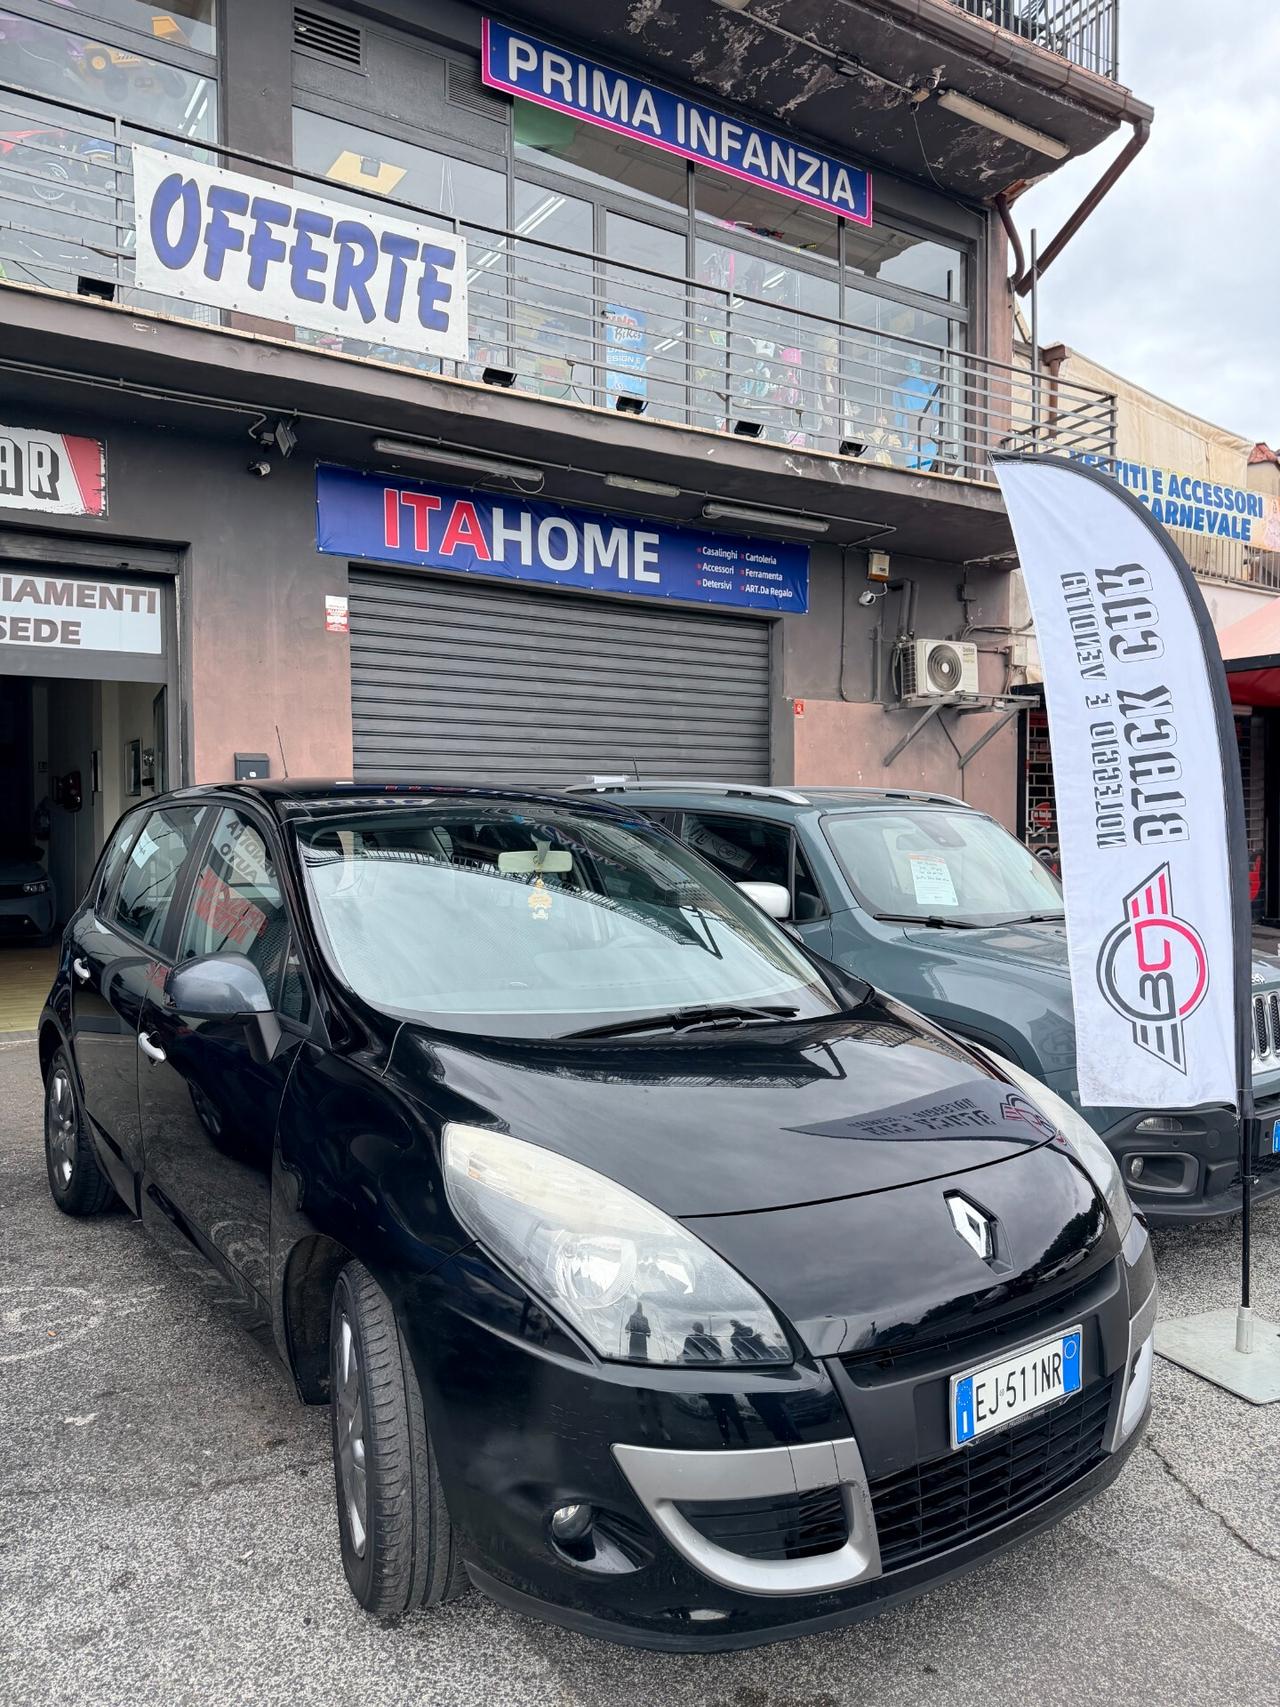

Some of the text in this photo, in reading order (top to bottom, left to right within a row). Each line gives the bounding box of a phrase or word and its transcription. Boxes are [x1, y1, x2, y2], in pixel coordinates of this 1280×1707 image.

[508, 36, 855, 210] PRIMA INFANZIA
[150, 173, 456, 332] OFFERTE
[1152, 469, 1164, 495] E
[1168, 473, 1264, 519] ACCESSORI
[383, 488, 661, 584] ITAHOME
[702, 546, 738, 560] Casalinghi
[745, 553, 777, 565] Cartoleria
[702, 562, 734, 575] Accessori
[745, 568, 783, 581] Ferramenta
[702, 578, 732, 590] Detersivi
[770, 588, 793, 599] Regalo
